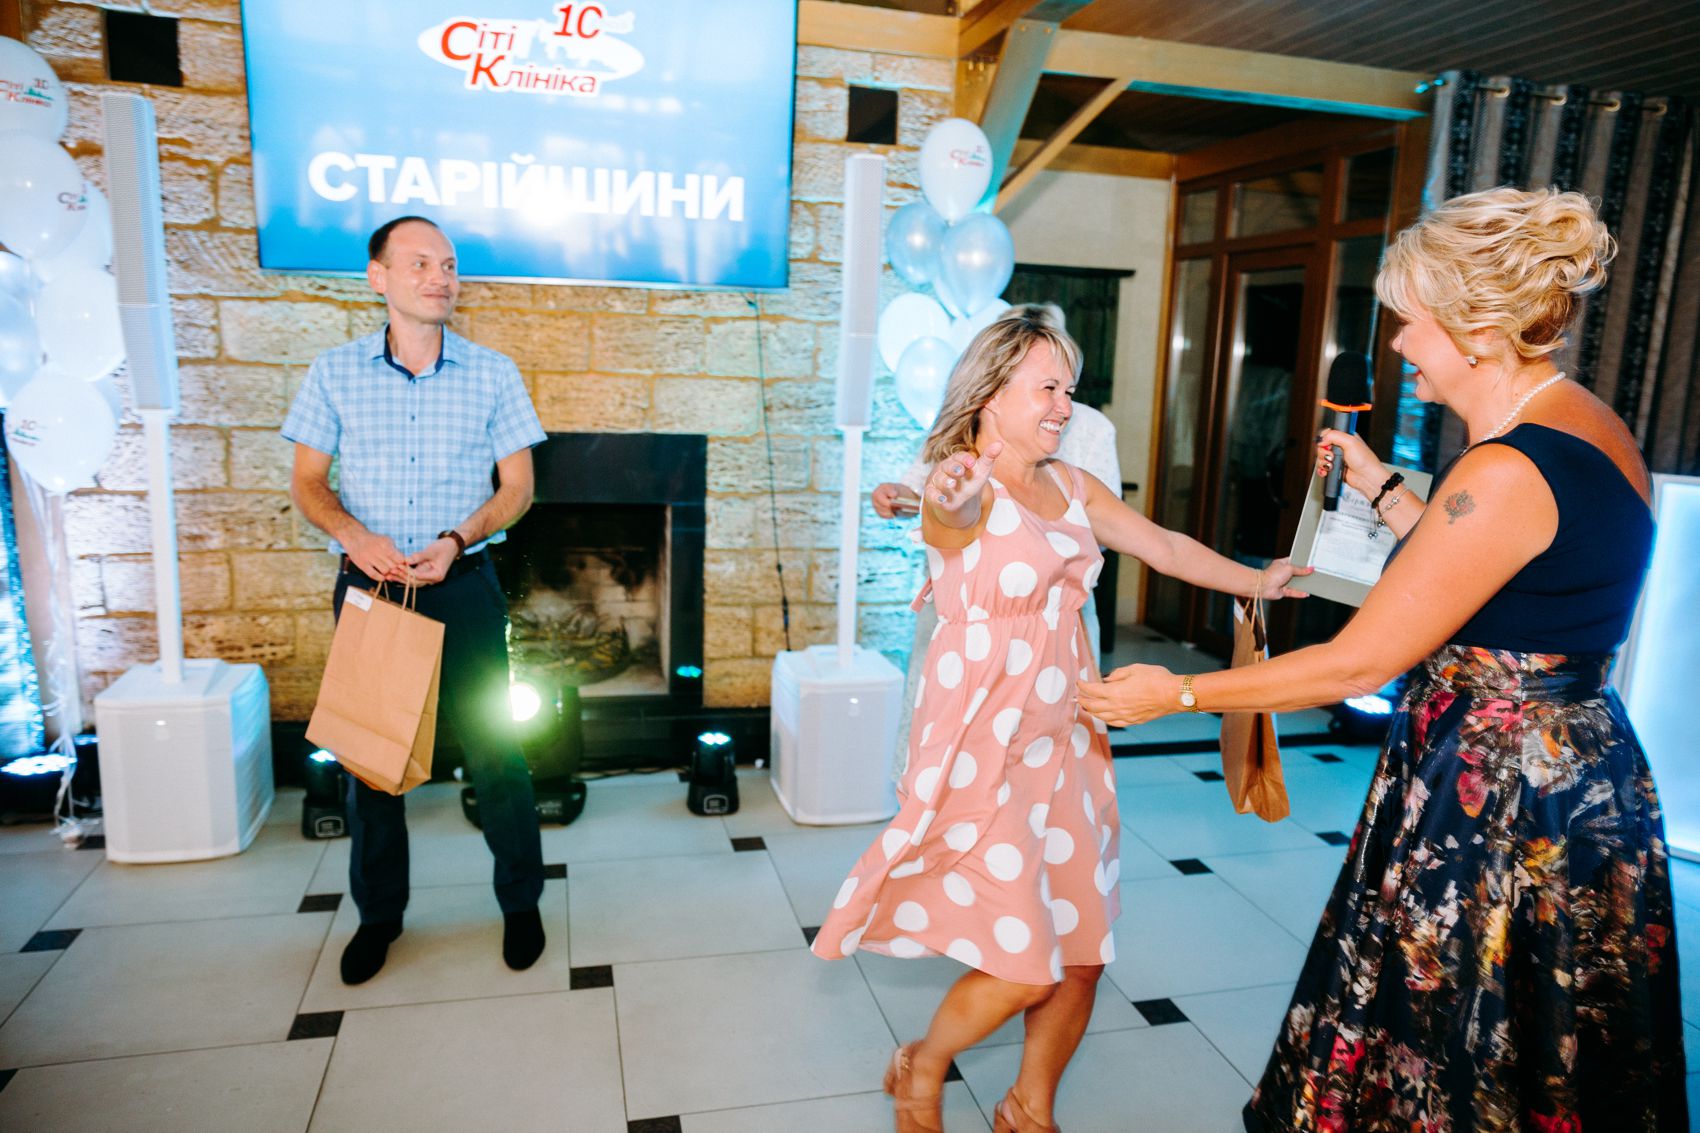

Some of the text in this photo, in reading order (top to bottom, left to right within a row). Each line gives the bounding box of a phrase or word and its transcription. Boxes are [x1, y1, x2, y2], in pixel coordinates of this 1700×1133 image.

[441, 21, 517, 61] Сіті
[470, 52, 597, 93] Клініка
[308, 151, 745, 222] СТАРІЙШИНИ
